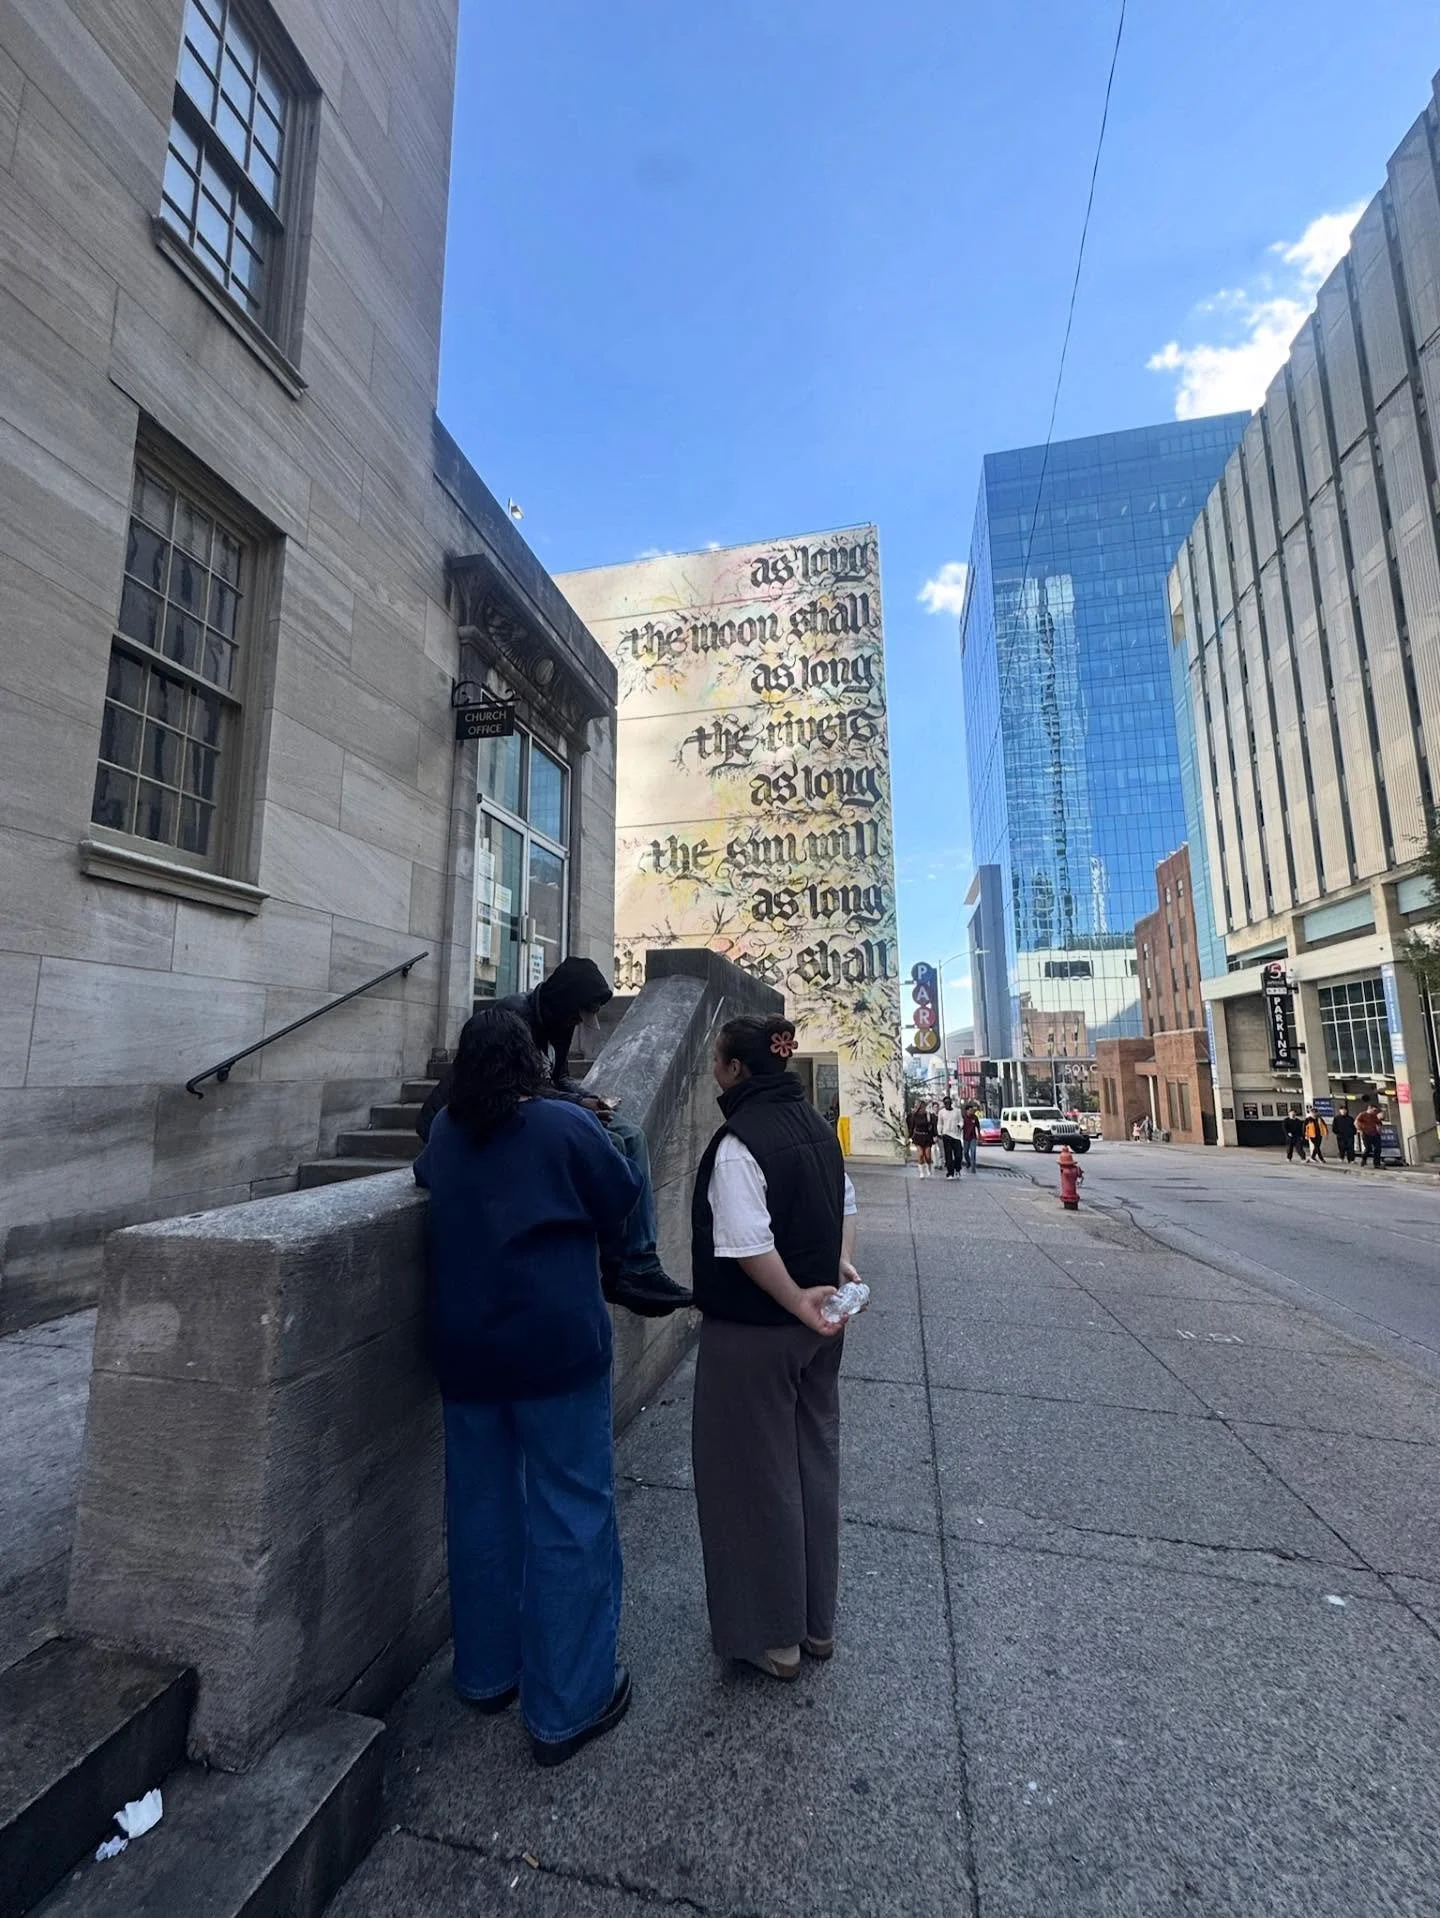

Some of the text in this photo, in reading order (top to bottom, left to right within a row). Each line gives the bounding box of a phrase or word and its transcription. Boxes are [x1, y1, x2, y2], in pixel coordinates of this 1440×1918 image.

[751, 544, 871, 588] as long
[621, 592, 878, 660] the moon shall
[750, 653, 877, 694] as long
[464, 710, 507, 722] CHURCH
[467, 723, 503, 735] OFFICE
[684, 709, 882, 763] the rivers
[751, 764, 884, 807] as long
[645, 819, 888, 873] the sun will
[752, 883, 889, 926] as long
[793, 937, 898, 991] shall
[916, 964, 932, 1048] PARK
[1273, 996, 1288, 1058] PARKING
